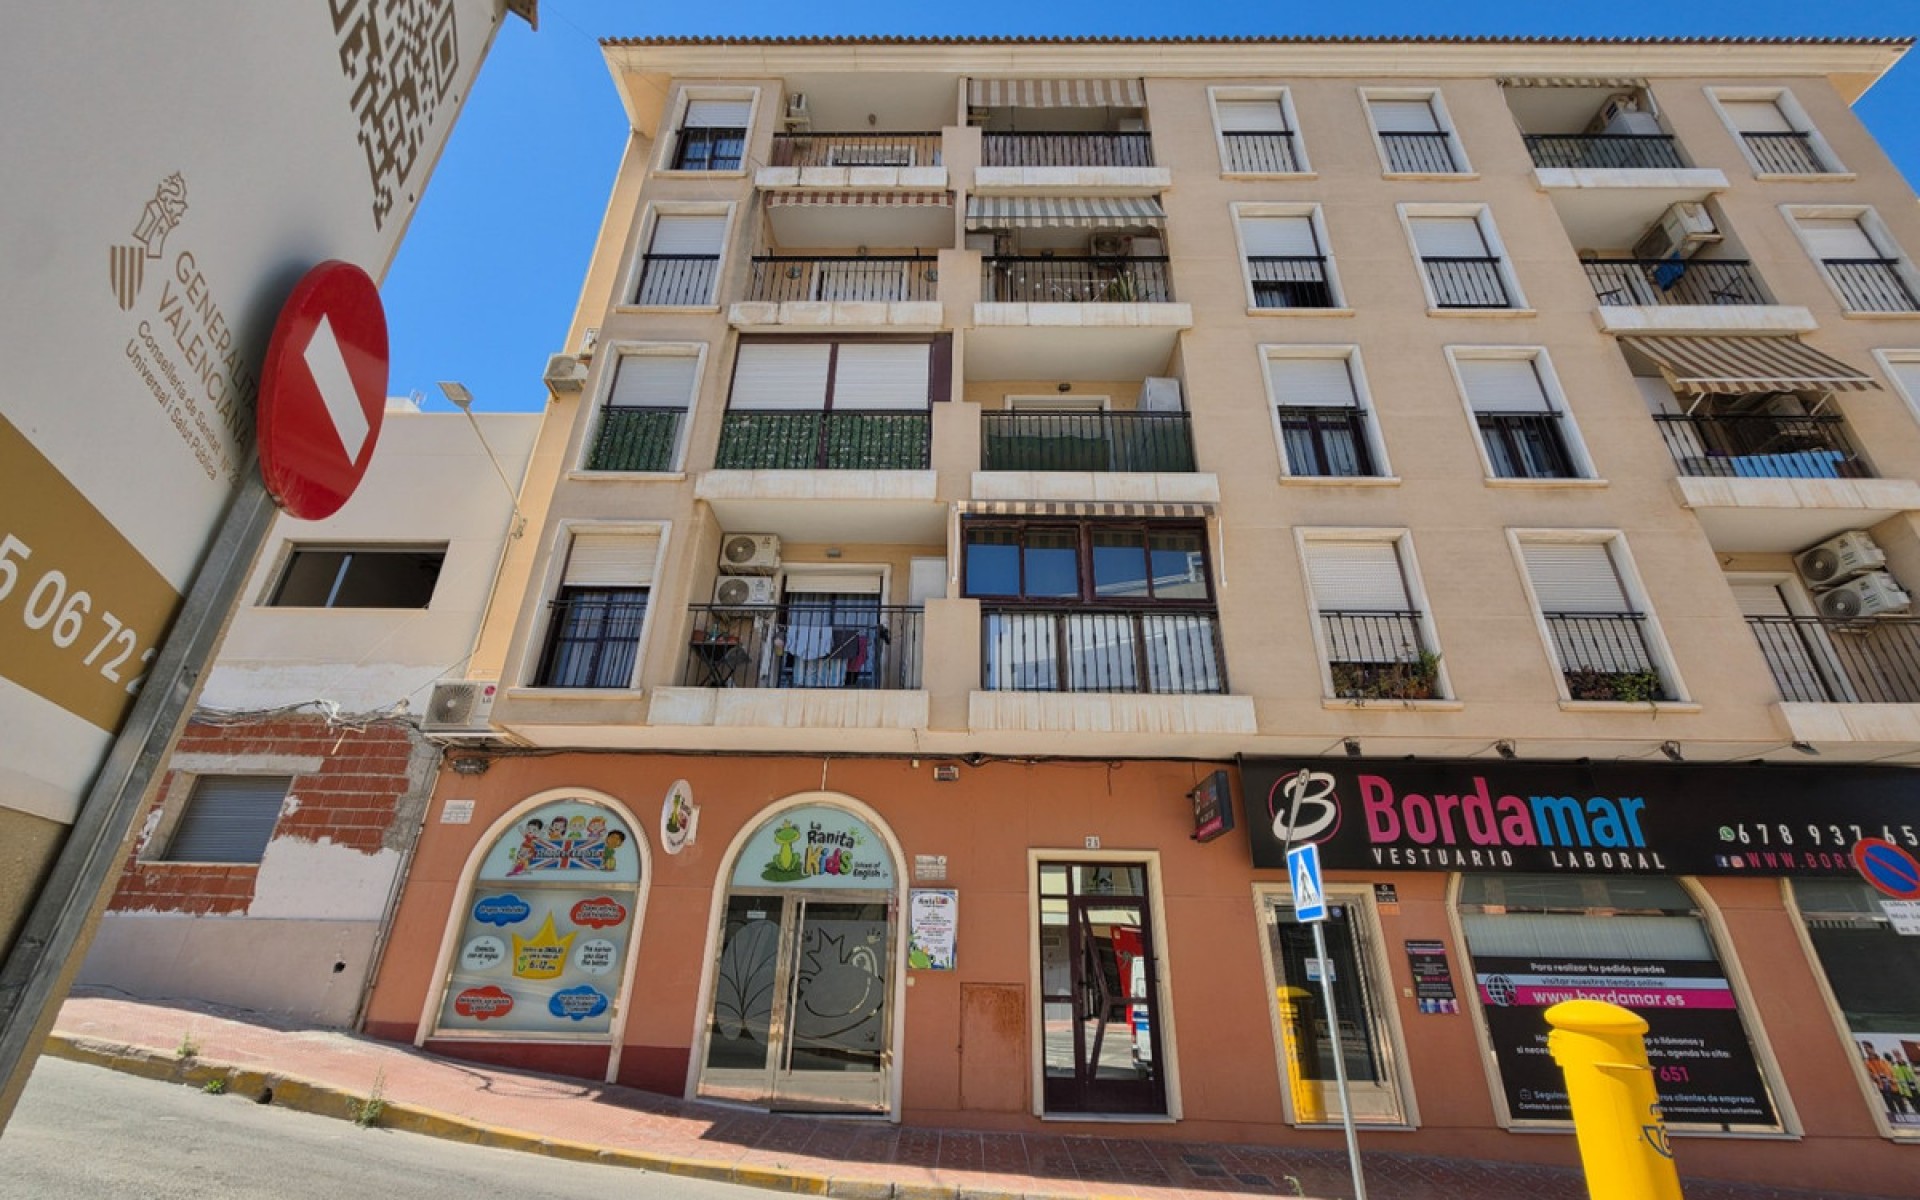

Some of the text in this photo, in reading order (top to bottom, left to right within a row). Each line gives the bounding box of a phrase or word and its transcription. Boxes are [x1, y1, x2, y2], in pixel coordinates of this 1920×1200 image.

[176, 251, 257, 413] GENERALITA
[139, 320, 186, 400] Conselleria
[185, 398, 197, 416] de
[159, 280, 247, 448] VALENCIANA
[126, 338, 171, 408] Universal
[171, 408, 193, 444] Salut
[23, 569, 92, 649] 06
[1358, 775, 1646, 848] Bordamar
[810, 821, 821, 830] La
[1737, 823, 1793, 845] 678
[1808, 824, 1862, 846] 937
[807, 830, 855, 848] Ranita
[804, 845, 853, 876] Kids
[1373, 848, 1666, 870] VESTUARIO LABORAL
[853, 868, 880, 880] English
[1530, 962, 1665, 977] Para realizar tu pedido puedes
[1532, 989, 1685, 1006] wwwbordamar.es
[1660, 1066, 1689, 1083] 651
